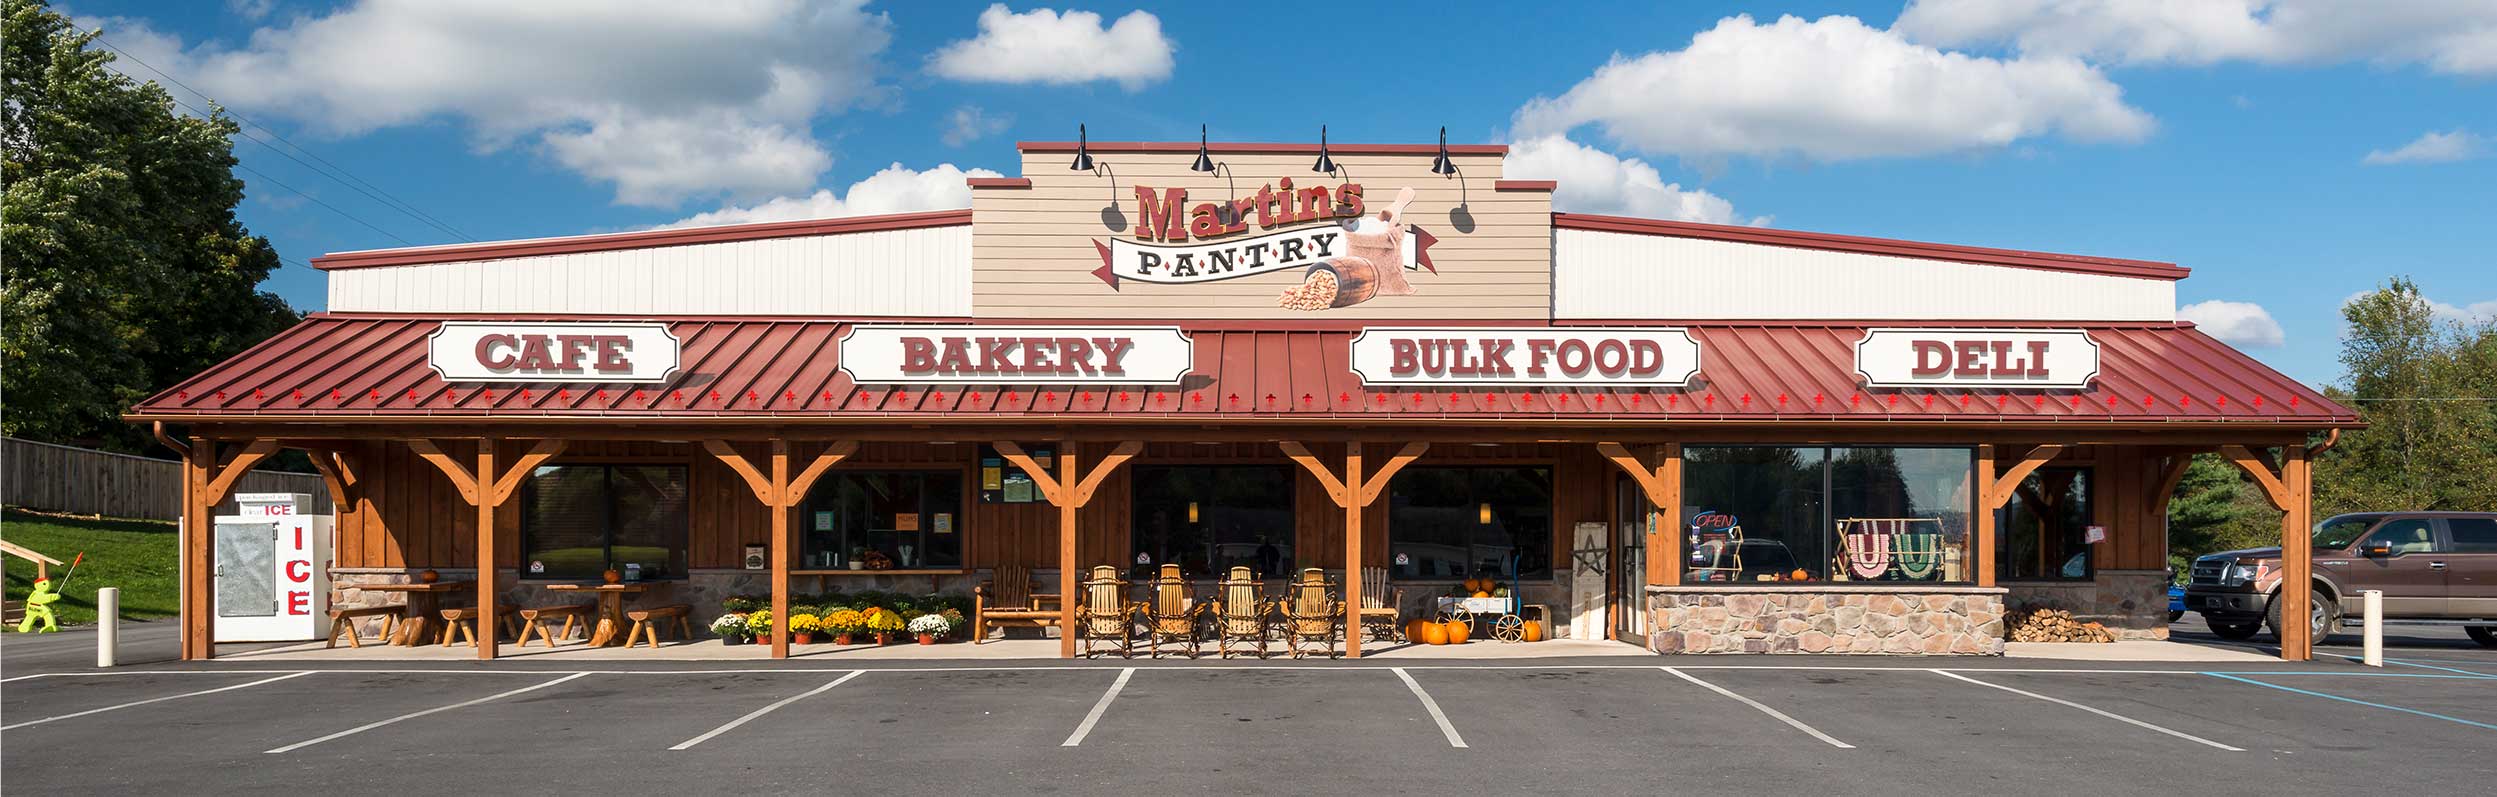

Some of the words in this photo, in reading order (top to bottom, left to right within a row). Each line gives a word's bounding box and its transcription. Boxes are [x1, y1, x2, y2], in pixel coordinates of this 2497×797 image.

[1135, 176, 1364, 242] Martins
[1137, 232, 1338, 277] PANTRY
[475, 334, 630, 372] CAFE
[900, 337, 1132, 374] BAKERY
[1390, 339, 1514, 375] BULK
[1527, 339, 1663, 375] FOOD
[1912, 340, 2050, 377] DELI
[264, 505, 292, 516] ICE
[1696, 515, 1734, 527] OPEN
[286, 526, 311, 615] ICE
